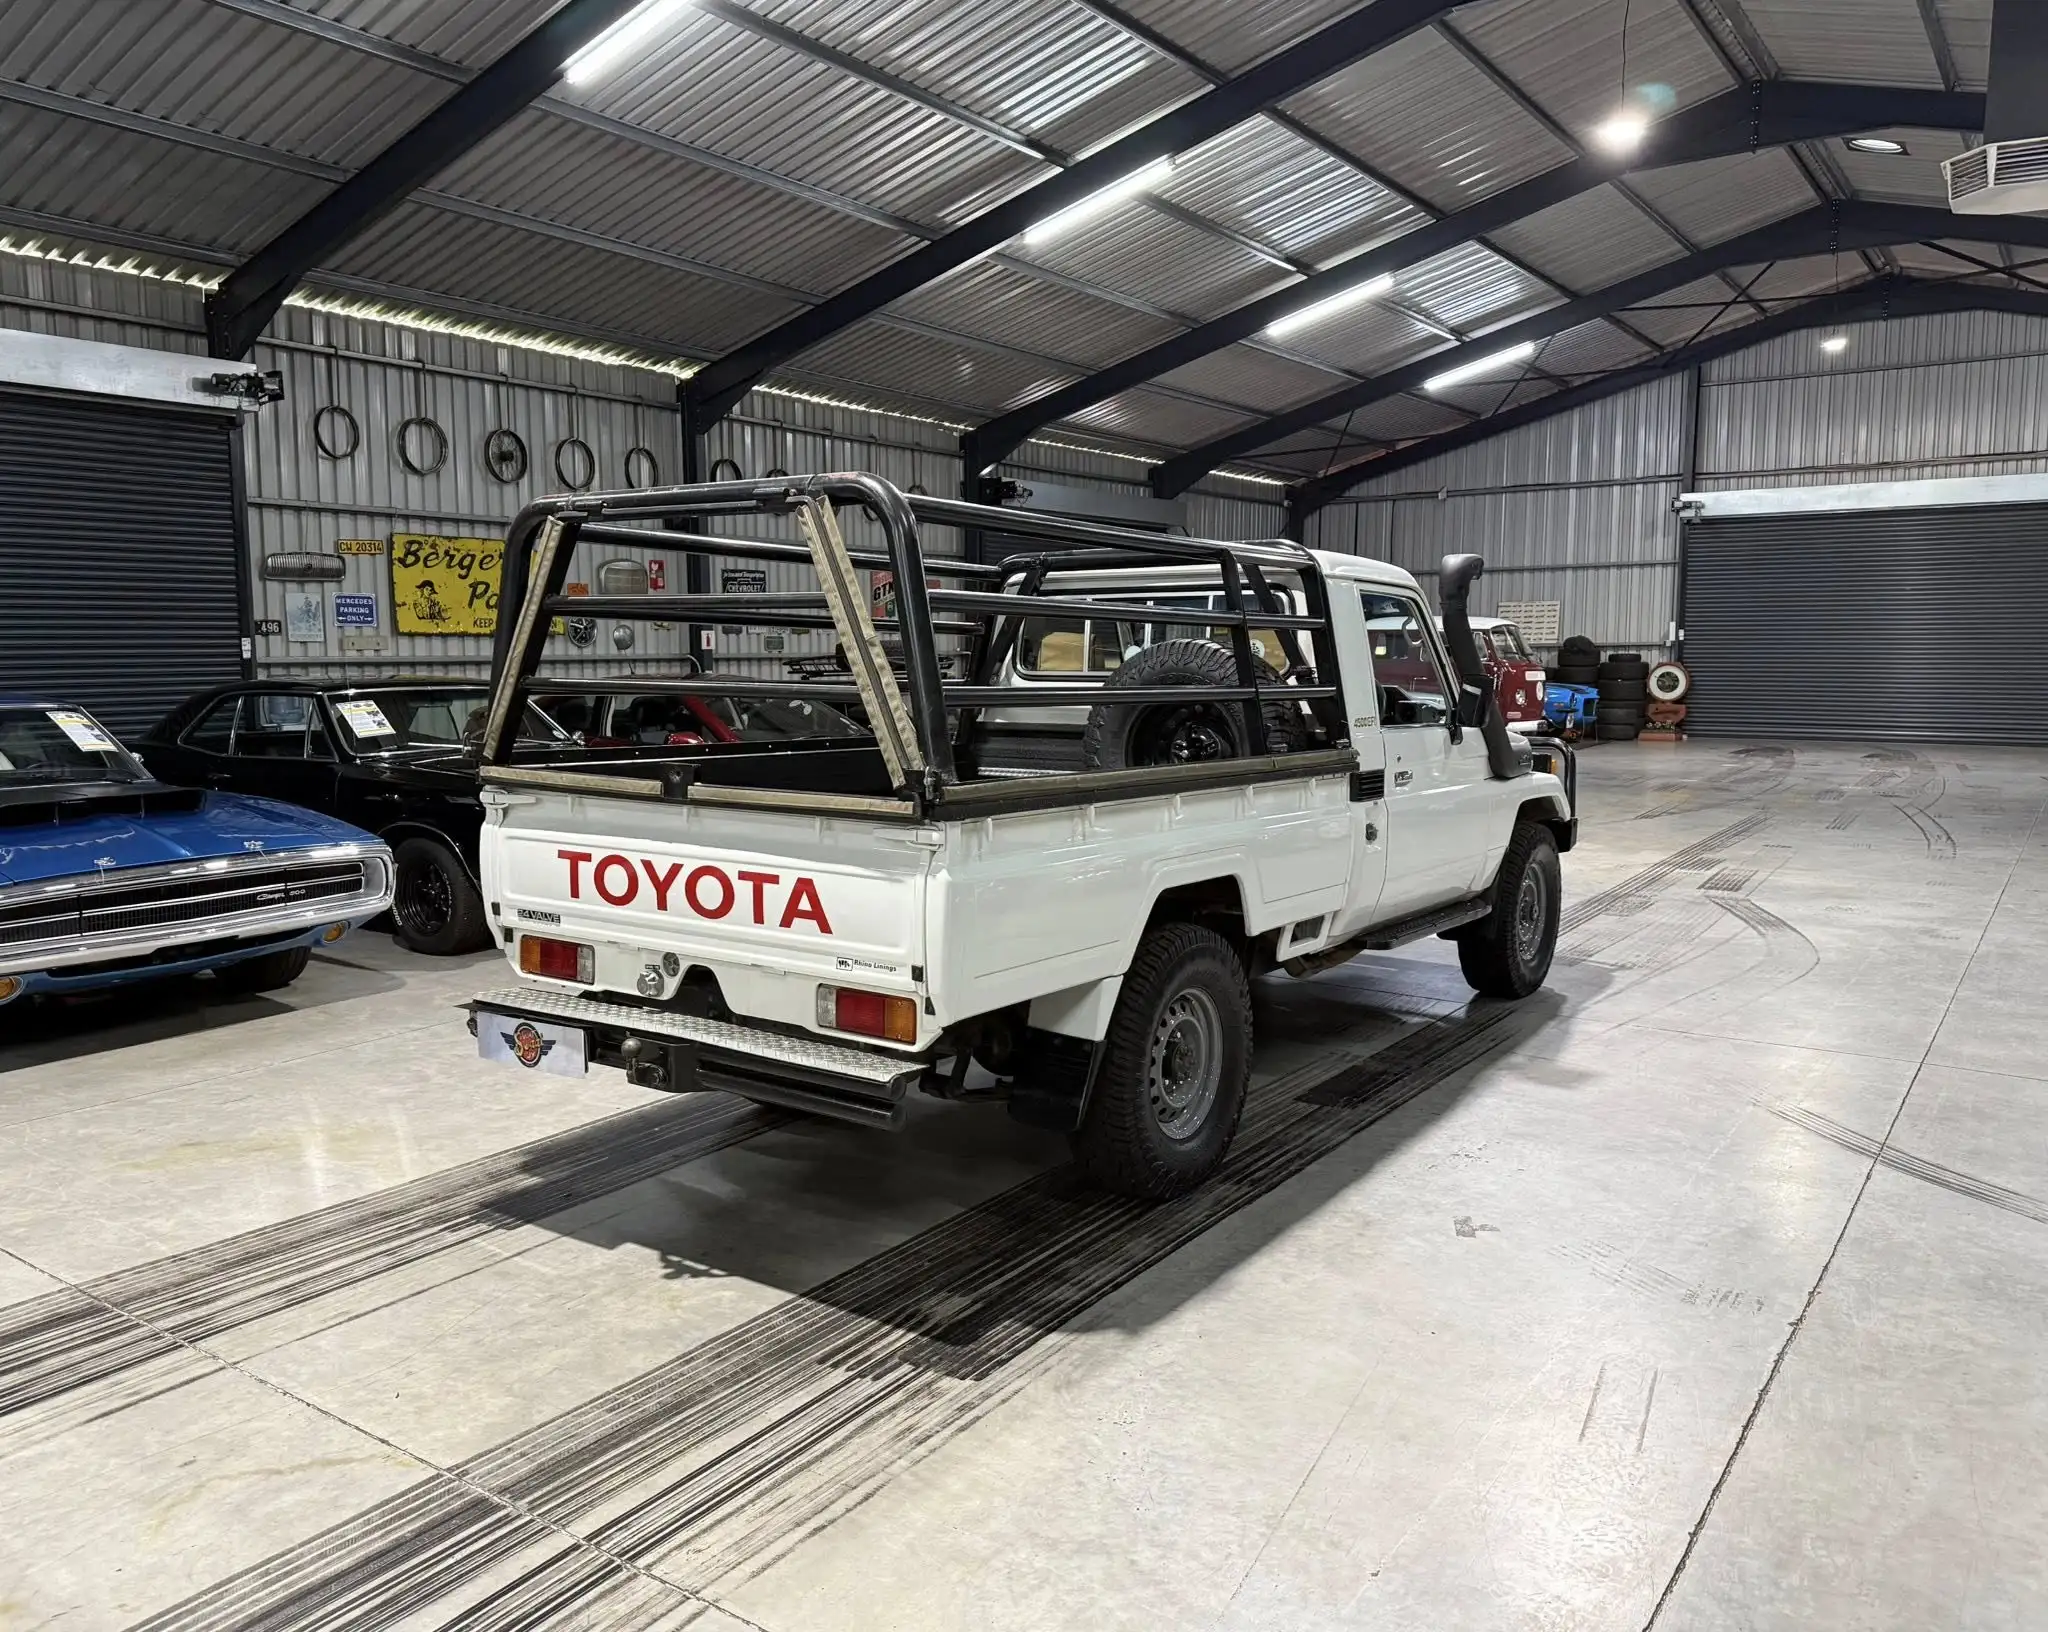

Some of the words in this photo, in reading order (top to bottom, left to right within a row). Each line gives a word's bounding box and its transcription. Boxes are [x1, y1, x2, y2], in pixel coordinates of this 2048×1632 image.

[355, 541, 382, 552] 20314
[397, 539, 503, 579] Berge
[727, 584, 761, 593] CHEVROLET
[340, 606, 369, 614] PARKING
[260, 622, 279, 633] 496
[473, 618, 494, 629] KEEP
[557, 849, 834, 935] TOYOTA
[530, 910, 561, 923] VALVE
[853, 959, 872, 968] Rhino
[873, 962, 897, 973] Linings
